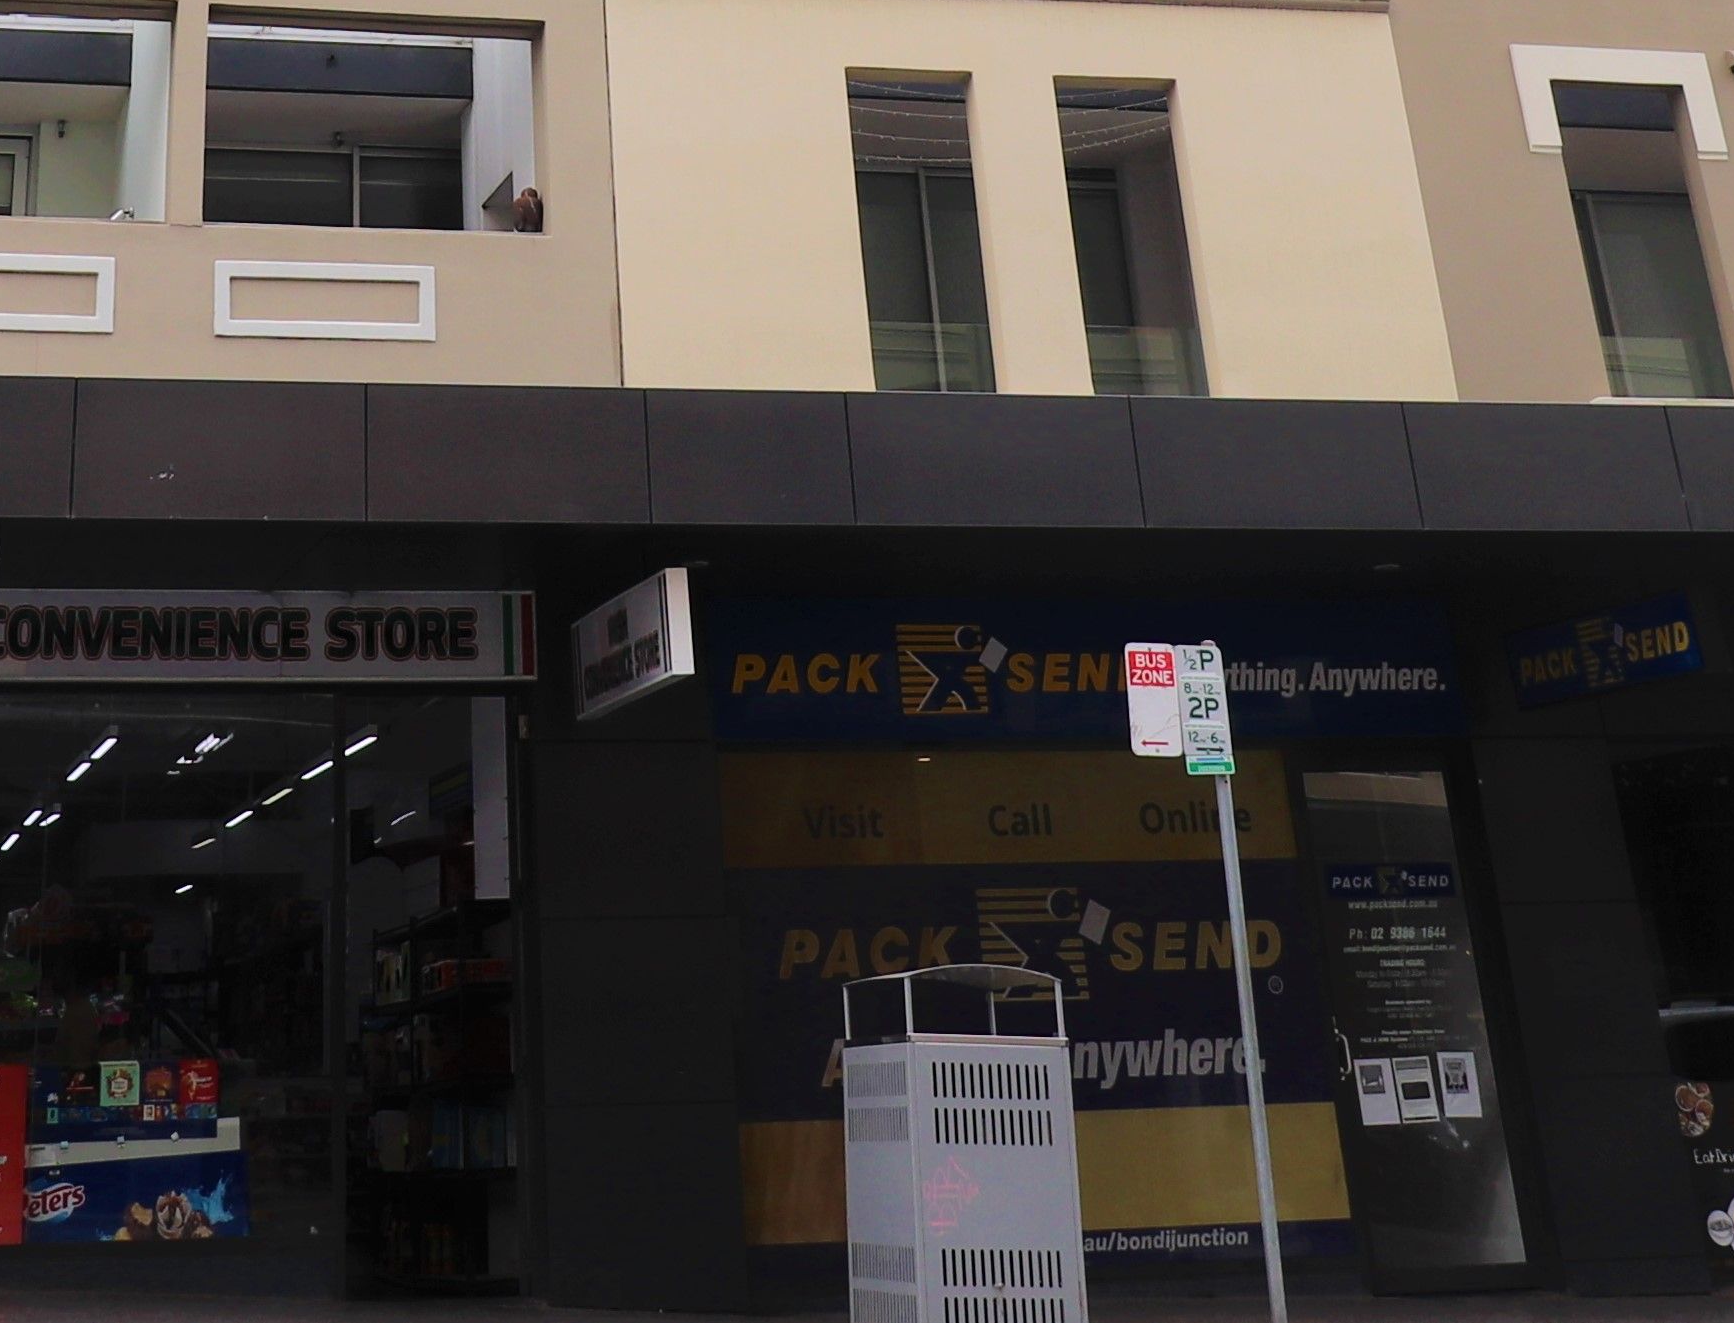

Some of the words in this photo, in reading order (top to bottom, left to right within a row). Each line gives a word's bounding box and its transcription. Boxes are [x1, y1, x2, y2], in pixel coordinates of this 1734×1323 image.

[325, 605, 479, 662] STORE
[1134, 653, 1167, 669] BUS
[1520, 647, 1578, 686] PACK
[1624, 620, 1690, 663] SEND
[730, 652, 880, 695] PACK
[1309, 660, 1447, 698] Anywhere.
[1131, 669, 1174, 685] ZONE
[1188, 696, 1219, 720] 2P
[803, 806, 884, 840] Visit
[986, 803, 1053, 837] Call
[1332, 875, 1374, 889] PACK
[1408, 874, 1450, 888] SEND
[779, 926, 957, 981] PACK
[1108, 919, 1284, 973] SEND
[1370, 927, 1384, 940] 02
[1070, 1028, 1266, 1091] nywhere.
[25, 1184, 87, 1221] eters
